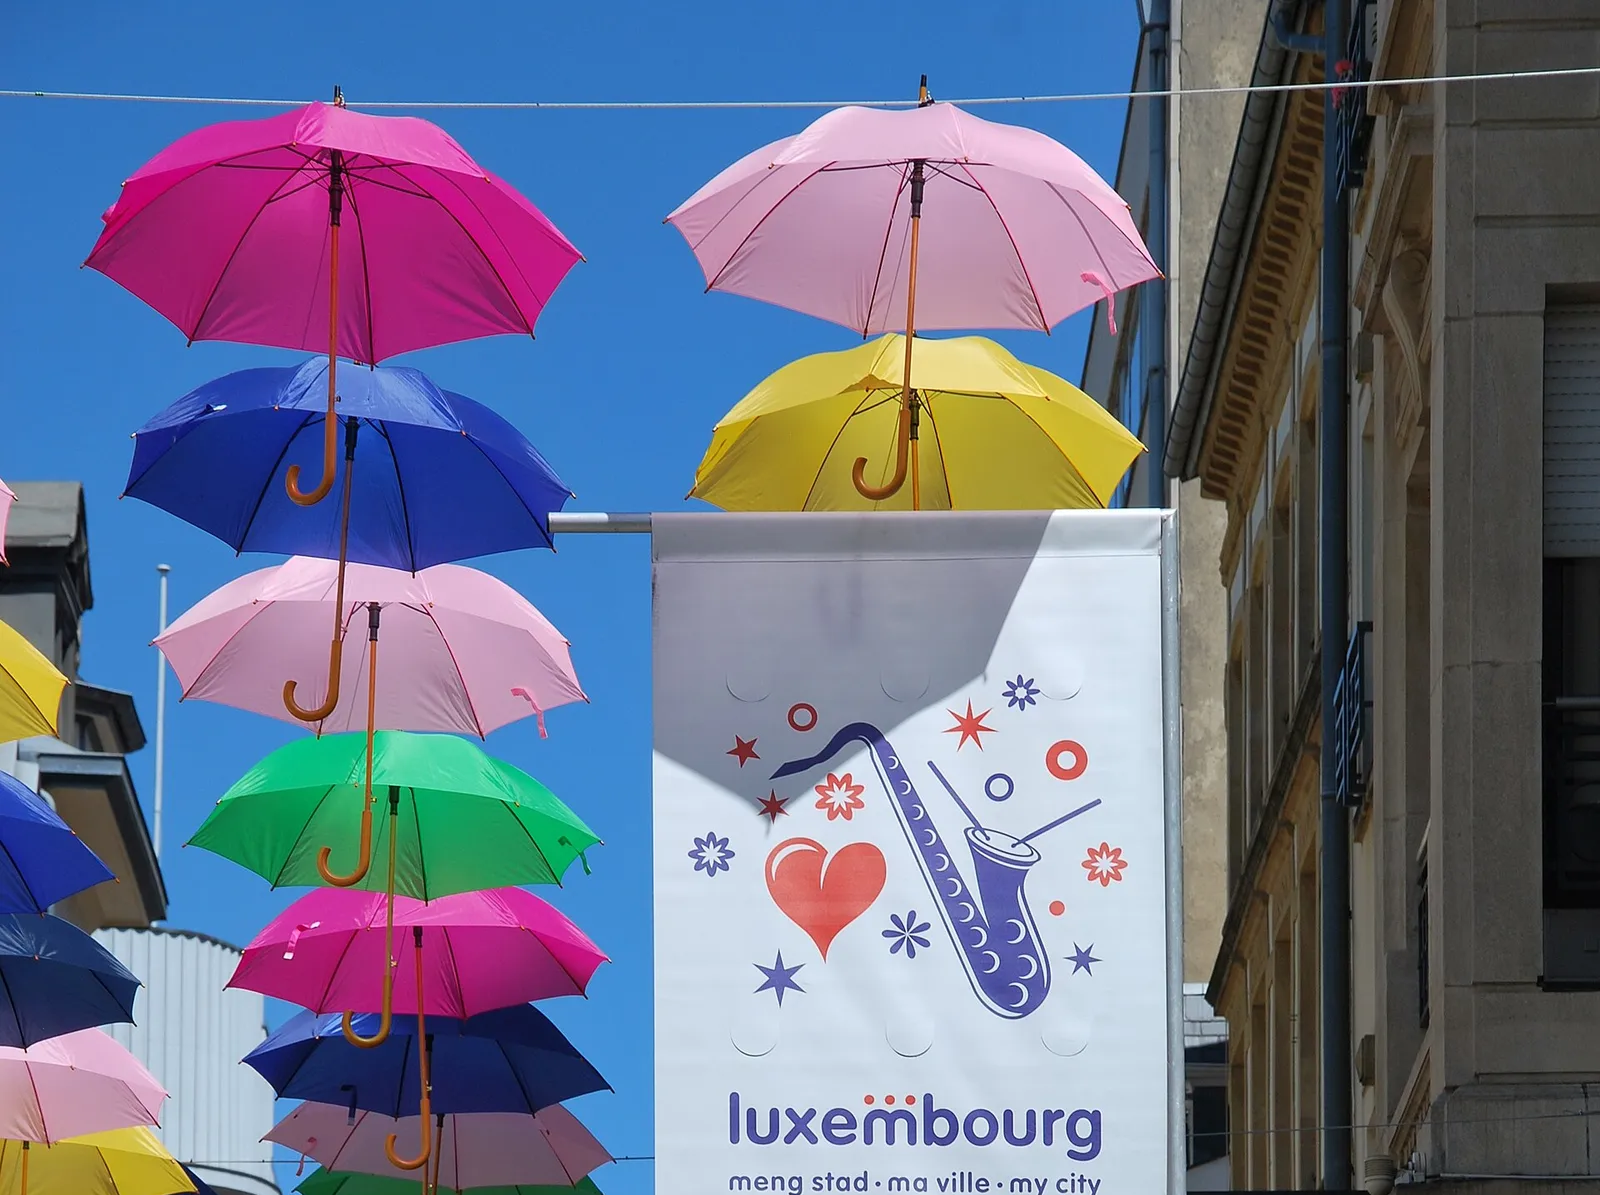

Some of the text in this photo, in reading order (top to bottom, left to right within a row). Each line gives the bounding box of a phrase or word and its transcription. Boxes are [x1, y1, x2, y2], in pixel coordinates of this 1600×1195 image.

[729, 1091, 1102, 1162] luxembourg
[811, 1170, 869, 1193] stad
[887, 1177, 928, 1193] ma
[936, 1171, 990, 1194] ville
